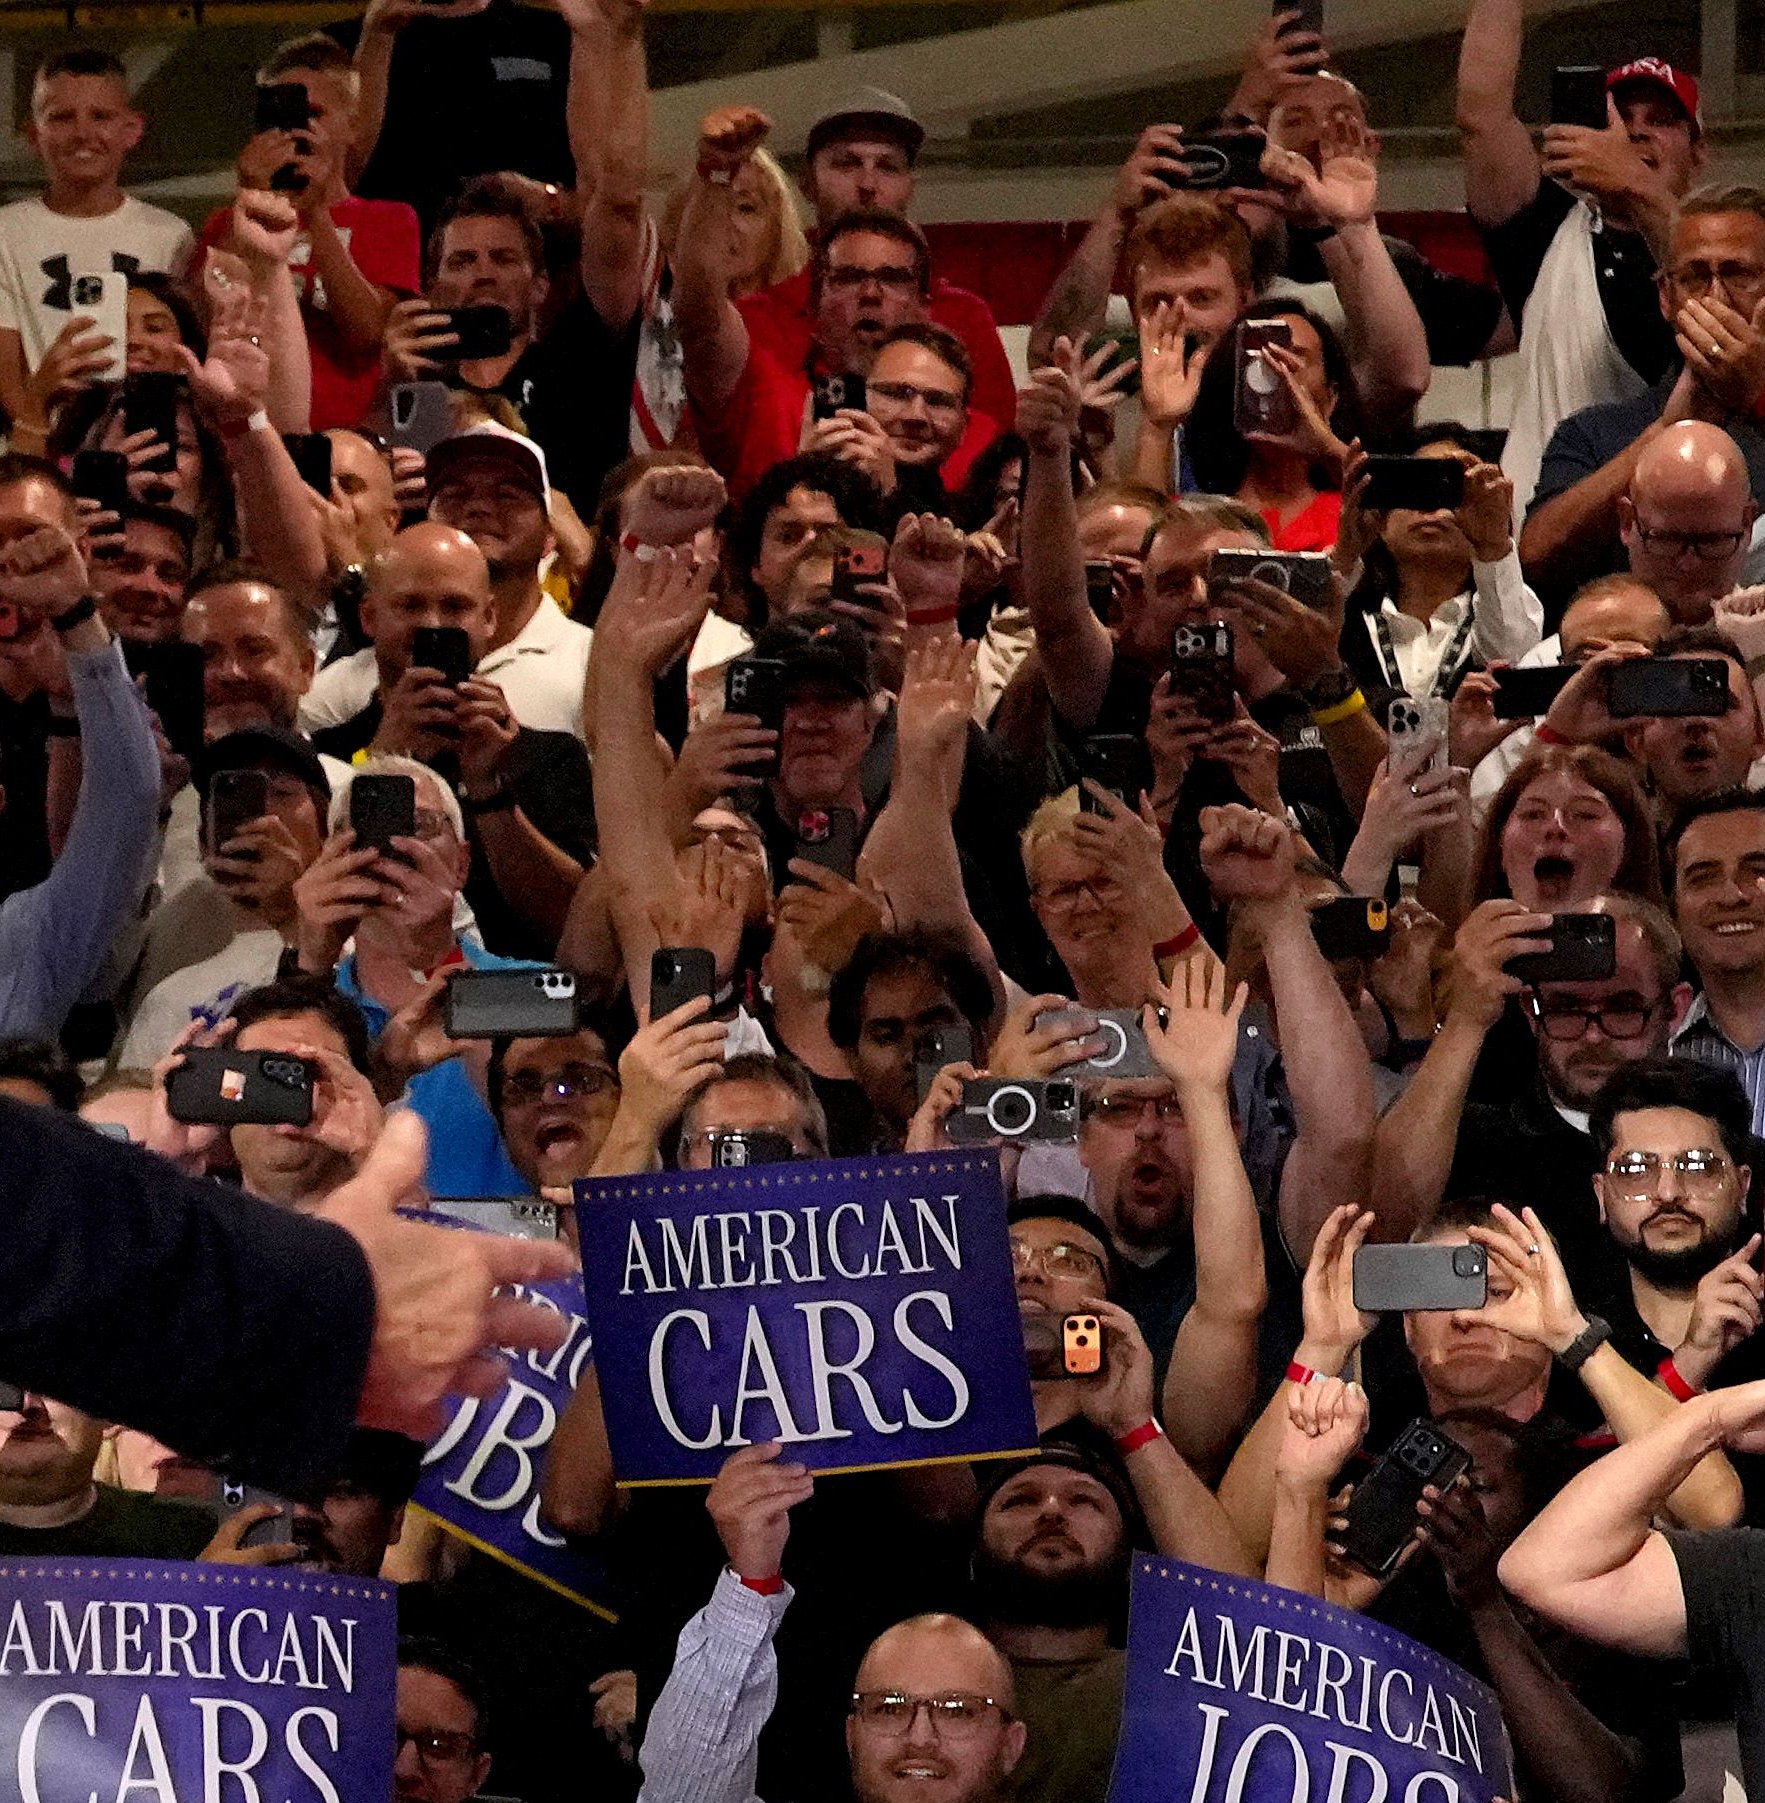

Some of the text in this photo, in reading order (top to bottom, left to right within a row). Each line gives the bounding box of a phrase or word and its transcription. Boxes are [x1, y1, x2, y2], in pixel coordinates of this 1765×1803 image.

[618, 1194, 964, 1295] AMERICAN
[648, 1290, 970, 1450] CARS
[1163, 1606, 1484, 1775] AMERICAN
